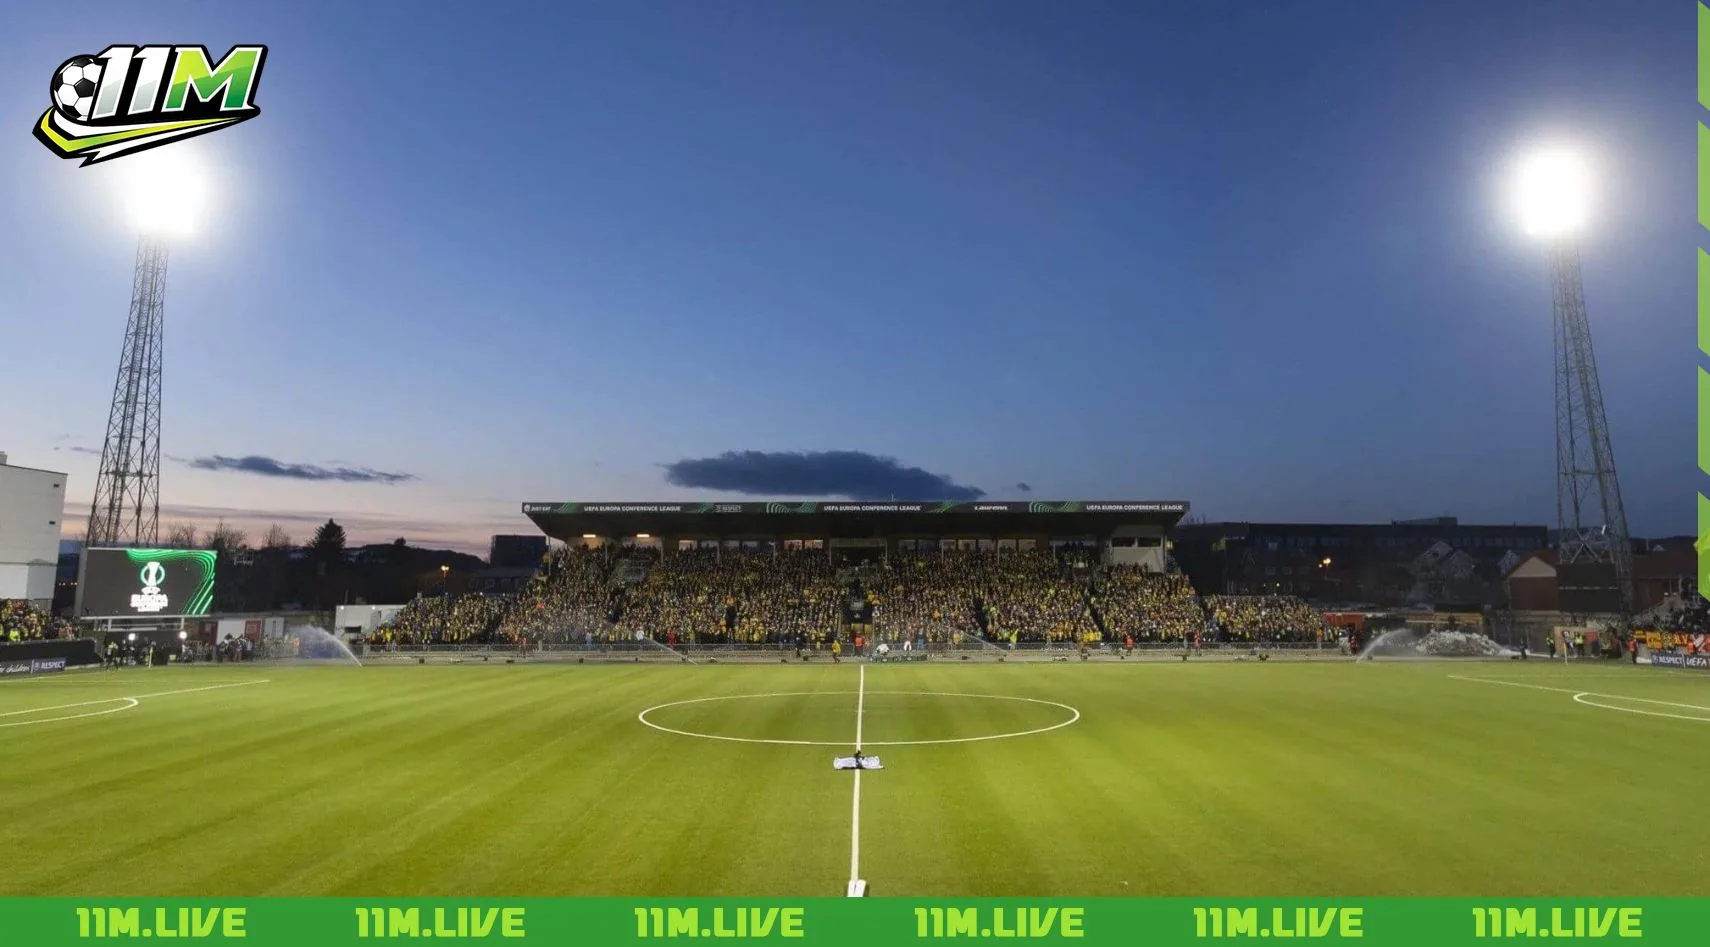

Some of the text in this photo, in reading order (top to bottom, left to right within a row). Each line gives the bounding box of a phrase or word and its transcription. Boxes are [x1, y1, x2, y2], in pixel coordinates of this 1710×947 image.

[1658, 655, 1682, 664] RESPECT
[1686, 657, 1708, 667] UEFA
[41, 661, 65, 669] RESPECT
